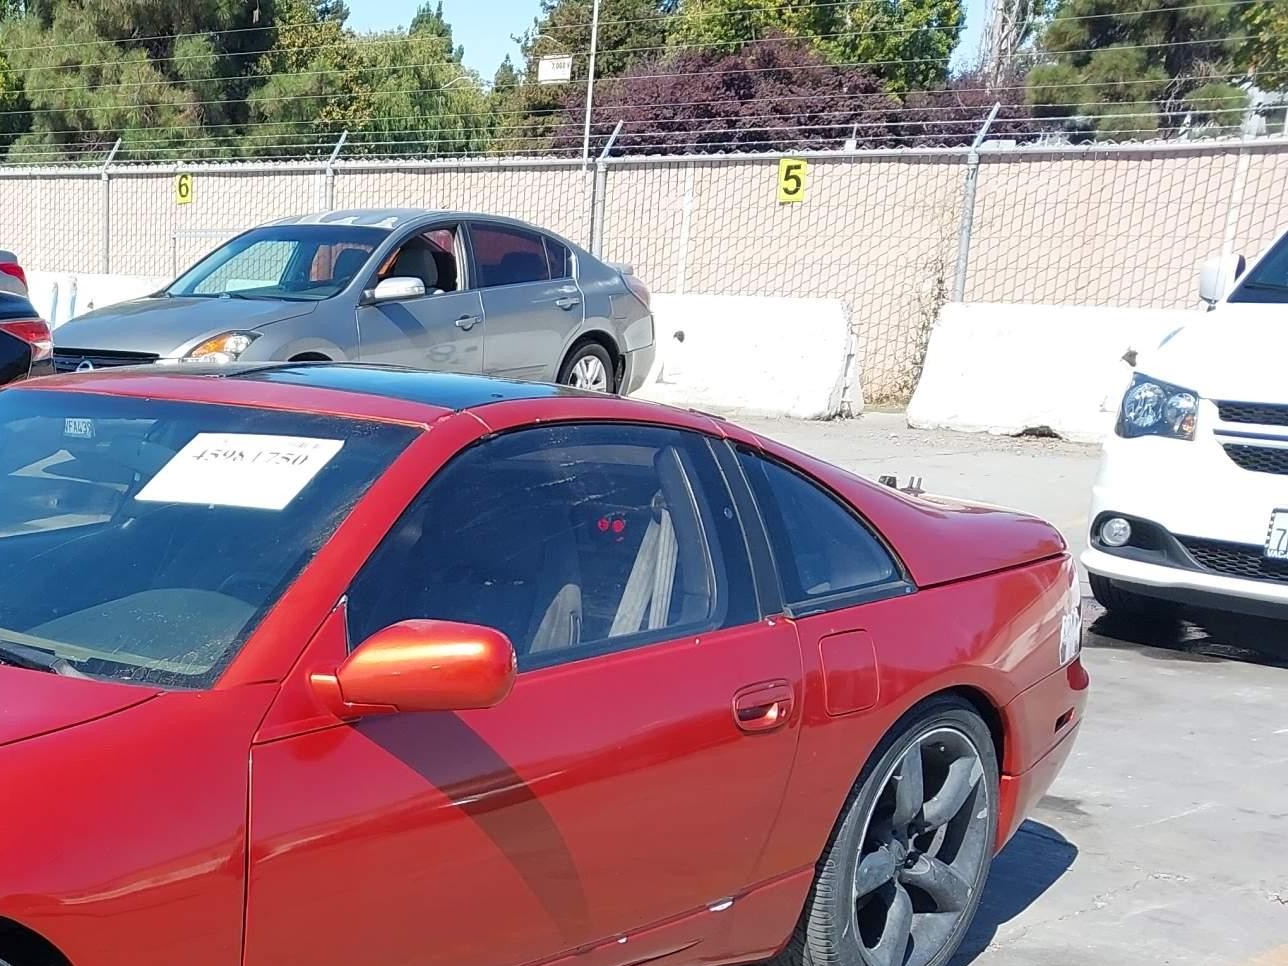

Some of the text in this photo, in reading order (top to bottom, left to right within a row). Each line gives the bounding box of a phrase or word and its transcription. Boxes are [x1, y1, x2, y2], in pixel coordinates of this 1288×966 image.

[178, 174, 190, 198] 6
[783, 164, 802, 195] 5
[1276, 528, 1288, 553] 7
